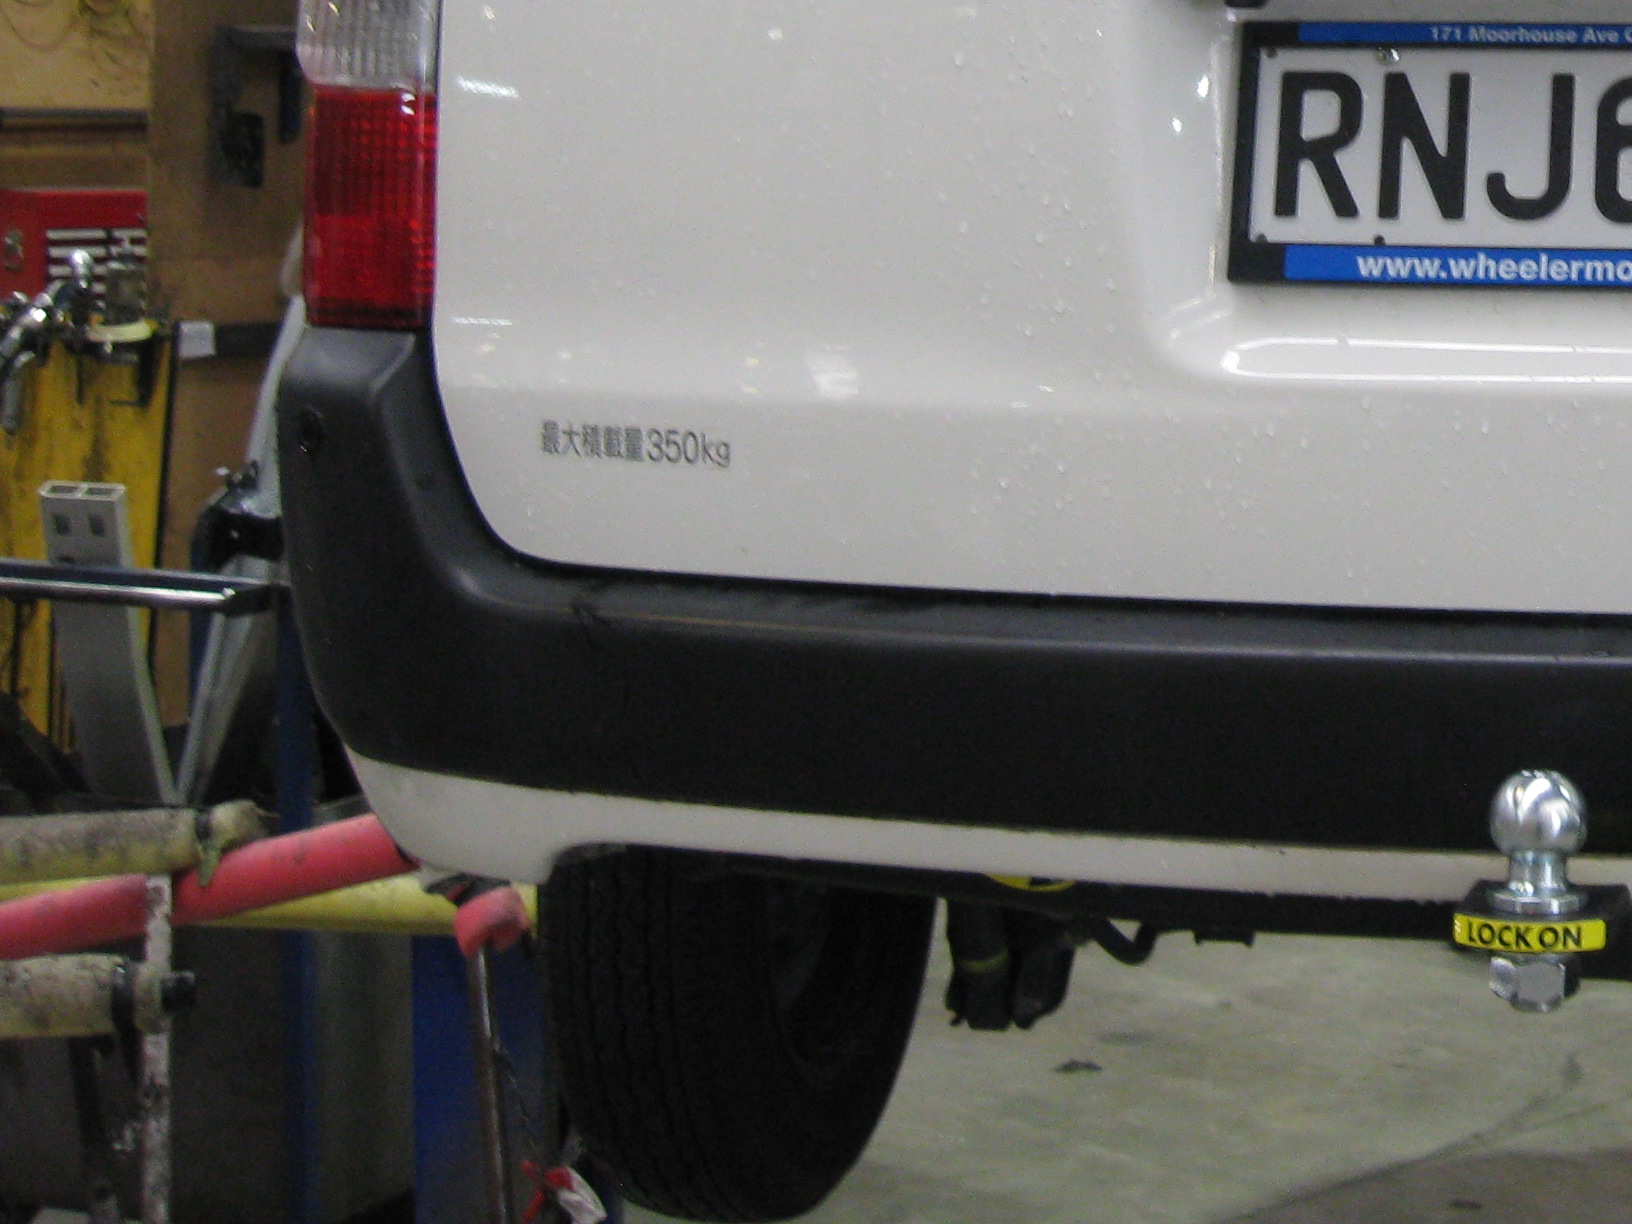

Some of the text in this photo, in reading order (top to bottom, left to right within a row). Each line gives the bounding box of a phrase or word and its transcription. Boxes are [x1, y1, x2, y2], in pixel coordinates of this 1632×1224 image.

[1430, 26, 1463, 42] 171
[1468, 27, 1578, 44] Moorhouse
[1582, 28, 1620, 44] Ave
[1467, 920, 1582, 949] LOCK ON
